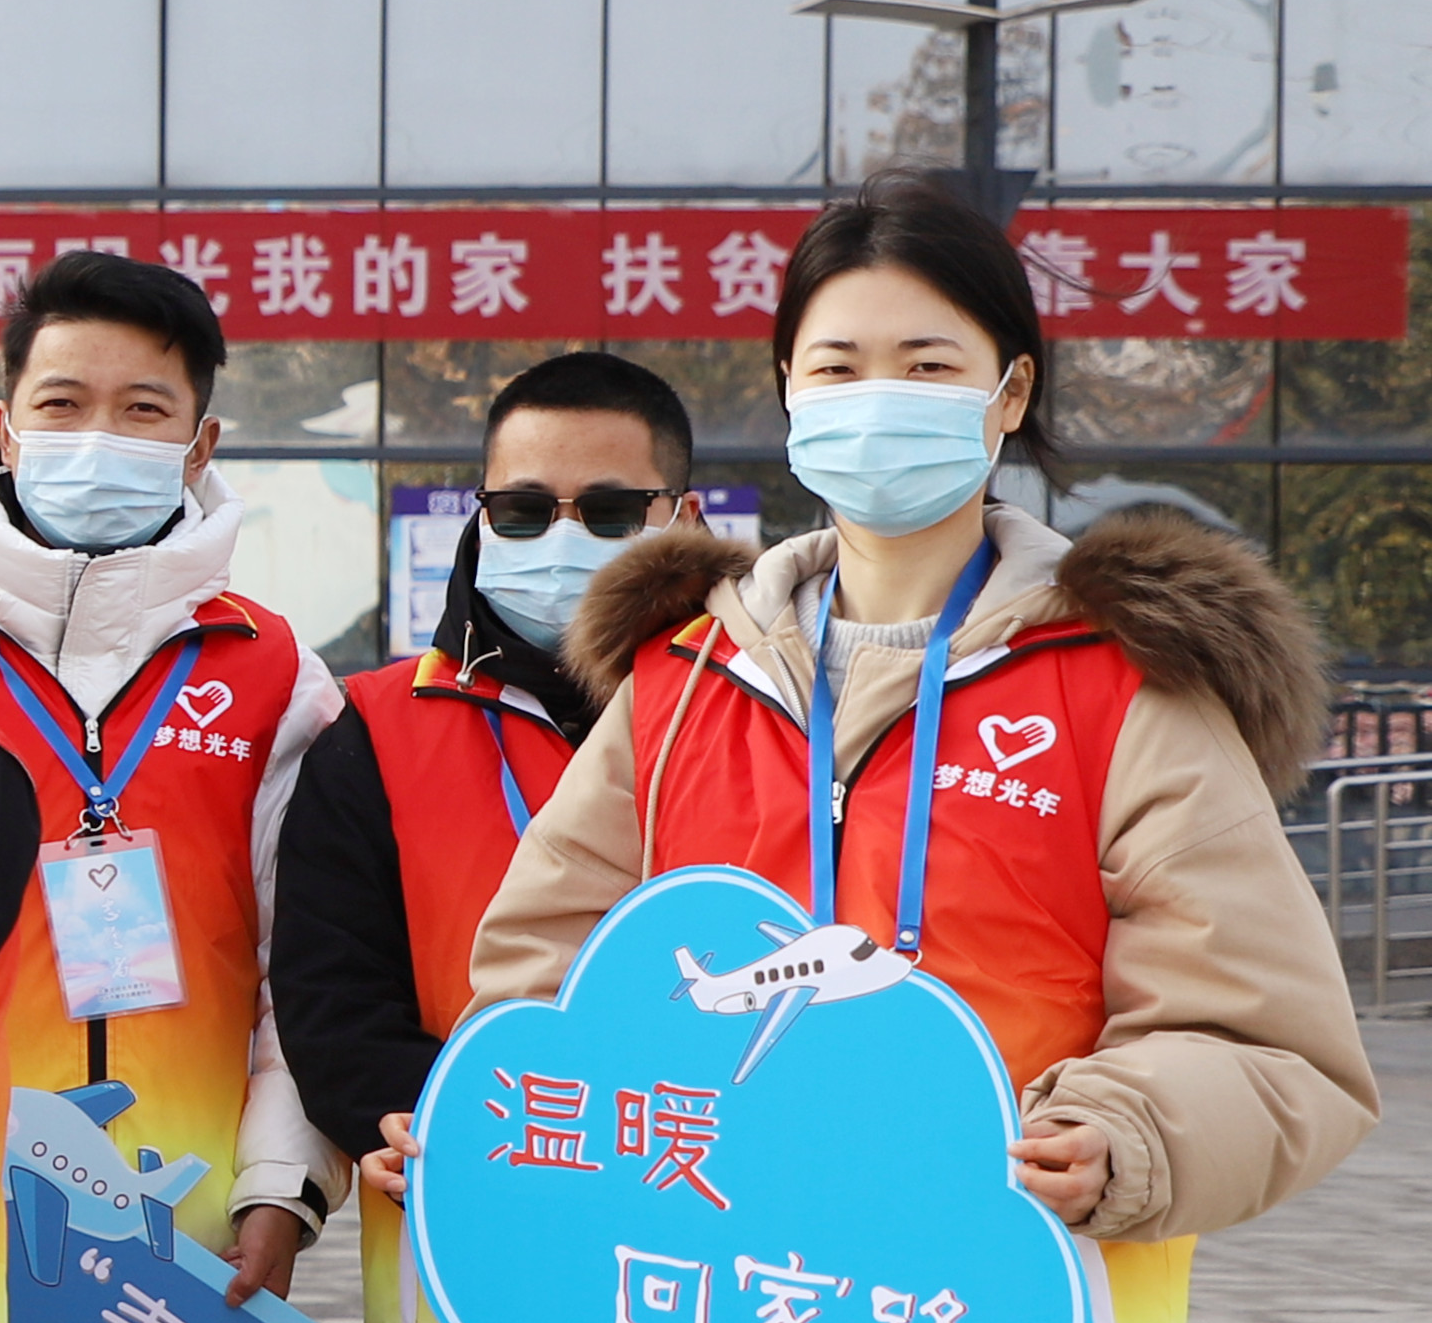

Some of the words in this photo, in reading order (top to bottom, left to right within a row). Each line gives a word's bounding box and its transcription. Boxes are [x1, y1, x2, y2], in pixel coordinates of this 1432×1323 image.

[601, 230, 1308, 317] 扶贫靠大家
[152, 725, 253, 763] 梦想光年
[932, 762, 1063, 820] 梦想光年
[484, 1067, 731, 1212] 温暖
